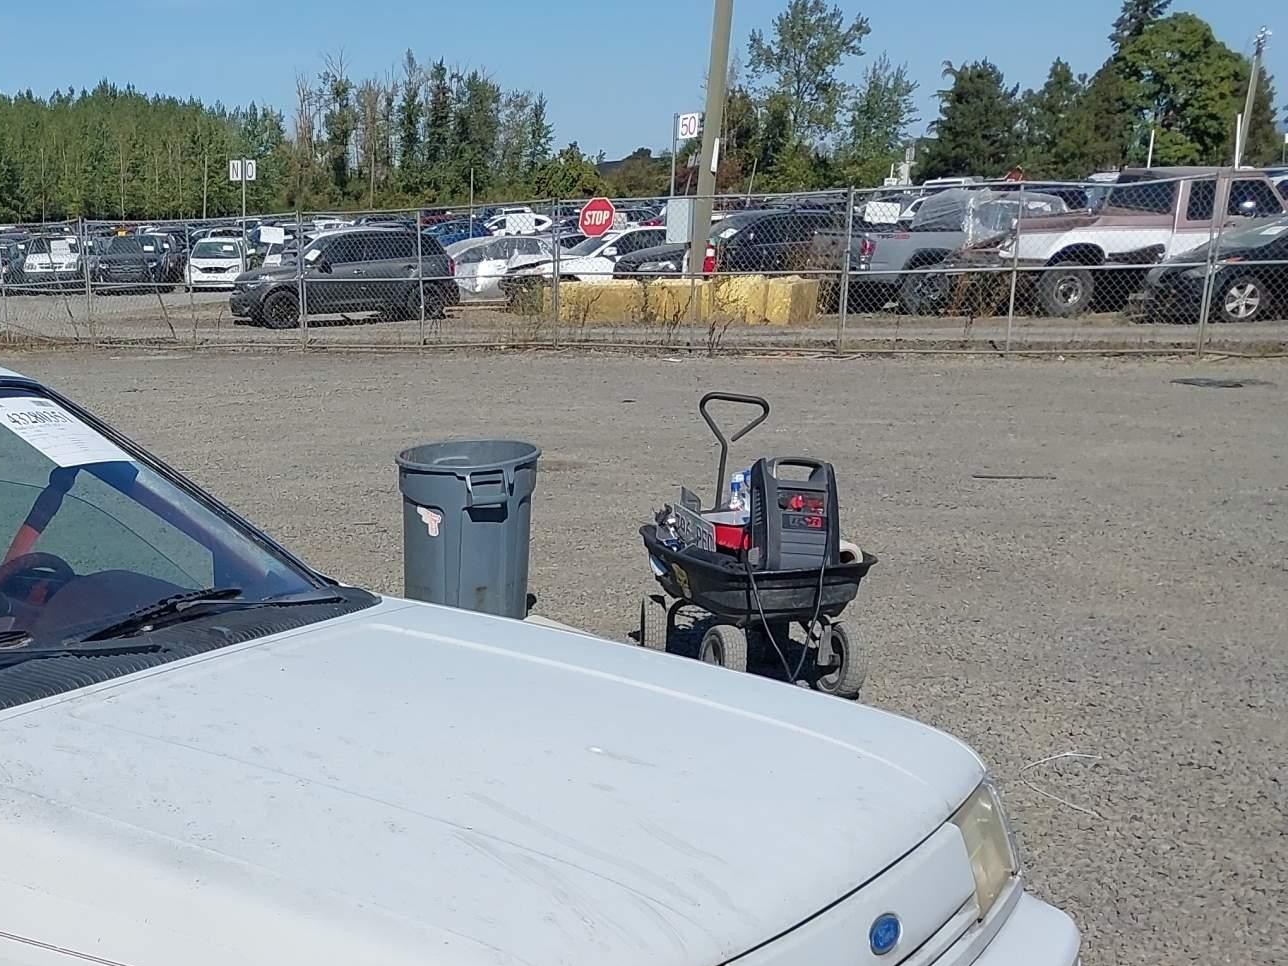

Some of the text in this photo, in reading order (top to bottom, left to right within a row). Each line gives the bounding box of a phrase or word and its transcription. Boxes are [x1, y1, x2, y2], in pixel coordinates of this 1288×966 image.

[680, 115, 697, 137] 50
[583, 210, 610, 226] STOP
[6, 410, 75, 425] 43280351
